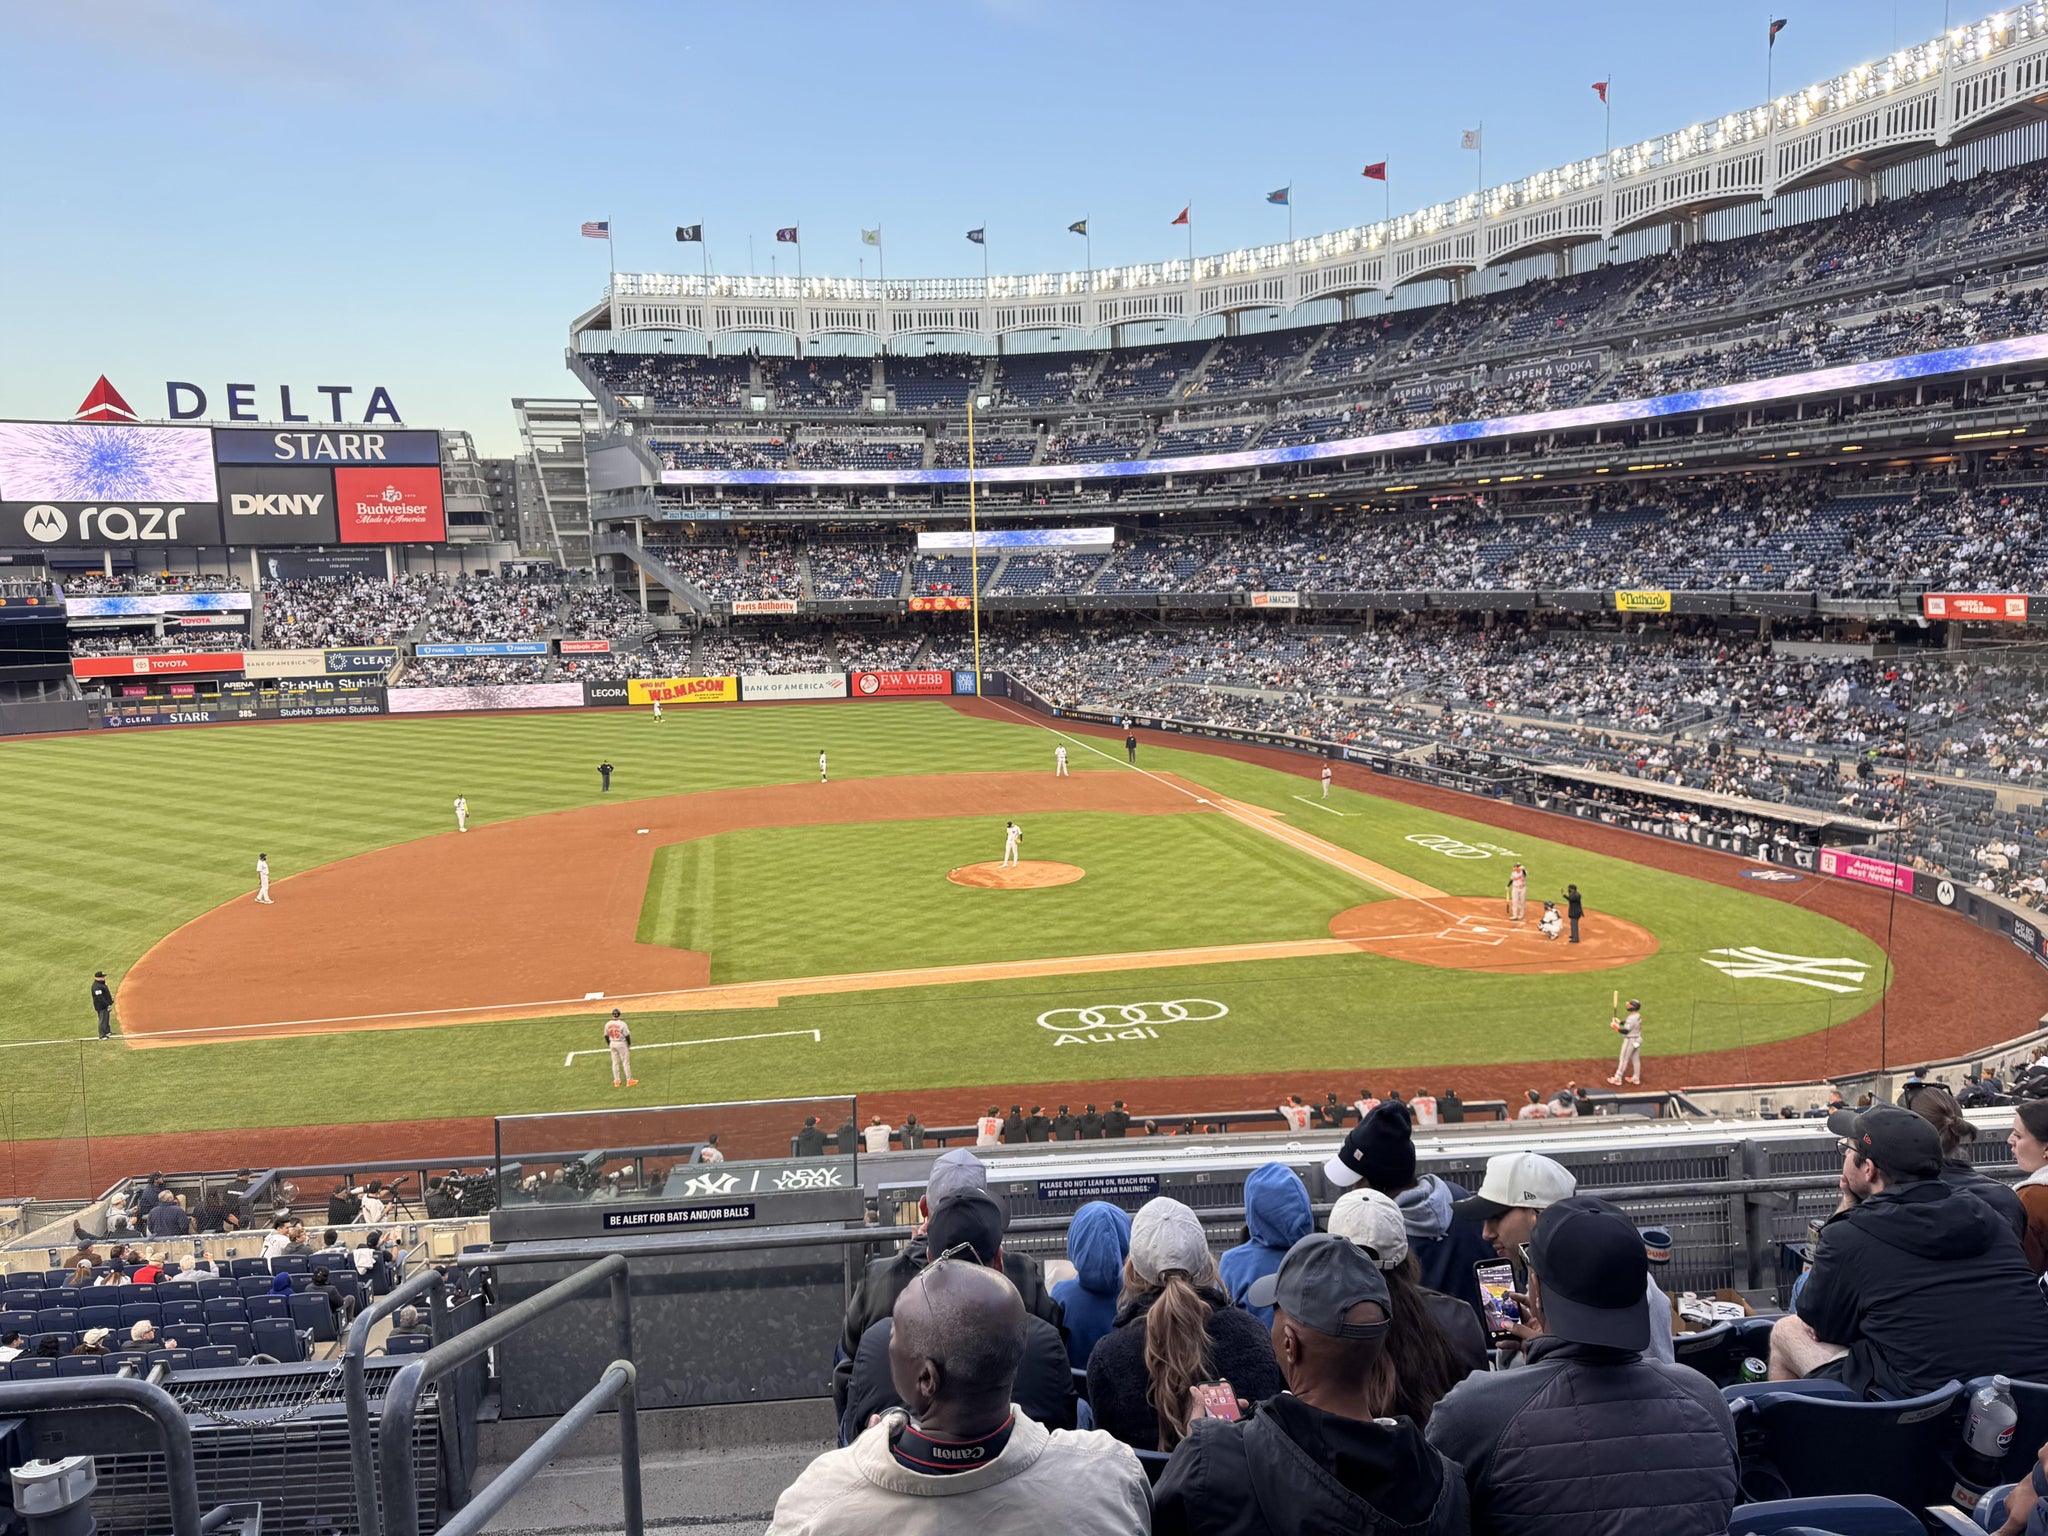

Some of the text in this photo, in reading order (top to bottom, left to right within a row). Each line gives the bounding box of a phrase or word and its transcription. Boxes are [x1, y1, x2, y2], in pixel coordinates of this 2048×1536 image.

[1507, 359, 1592, 382] ASPEN VODKA
[1393, 379, 1465, 399] ASPEN VODKA
[166, 381, 402, 423] DELTA
[274, 433, 387, 460] STARR
[231, 494, 324, 516] DKNY
[356, 502, 427, 515] Budweiser
[78, 507, 186, 541] razr
[356, 515, 427, 525] Made of America
[736, 602, 793, 612] Parts Authority
[152, 659, 189, 669] TOYOTA
[353, 657, 391, 666] CLEAR
[280, 678, 377, 690] StubHub StubH
[880, 674, 943, 686] F.W. WEBB
[591, 688, 628, 698] LEGORA
[170, 712, 209, 723] STARR
[280, 708, 312, 717] StubHub
[315, 707, 347, 715] StubHub
[1846, 866, 1866, 878] Best
[1053, 1027, 1159, 1047] Audi
[772, 1176, 851, 1193] YORK
[1040, 1180, 1062, 1189] PLEASE
[1064, 1180, 1073, 1188] DO
[1074, 1179, 1087, 1187] NOT
[1088, 1178, 1104, 1186] LEAN
[1117, 1177, 1137, 1185] REACH
[1139, 1176, 1157, 1184] OVER,
[1048, 1189, 1057, 1197] SIT
[1058, 1188, 1068, 1196] ON
[1069, 1188, 1078, 1196] OR
[1079, 1187, 1100, 1195] STAND
[1101, 1186, 1118, 1194] NEAR
[610, 1207, 749, 1225] BE ALERT FOR BATS AND/OR BALLS
[932, 1447, 985, 1460] Canon
